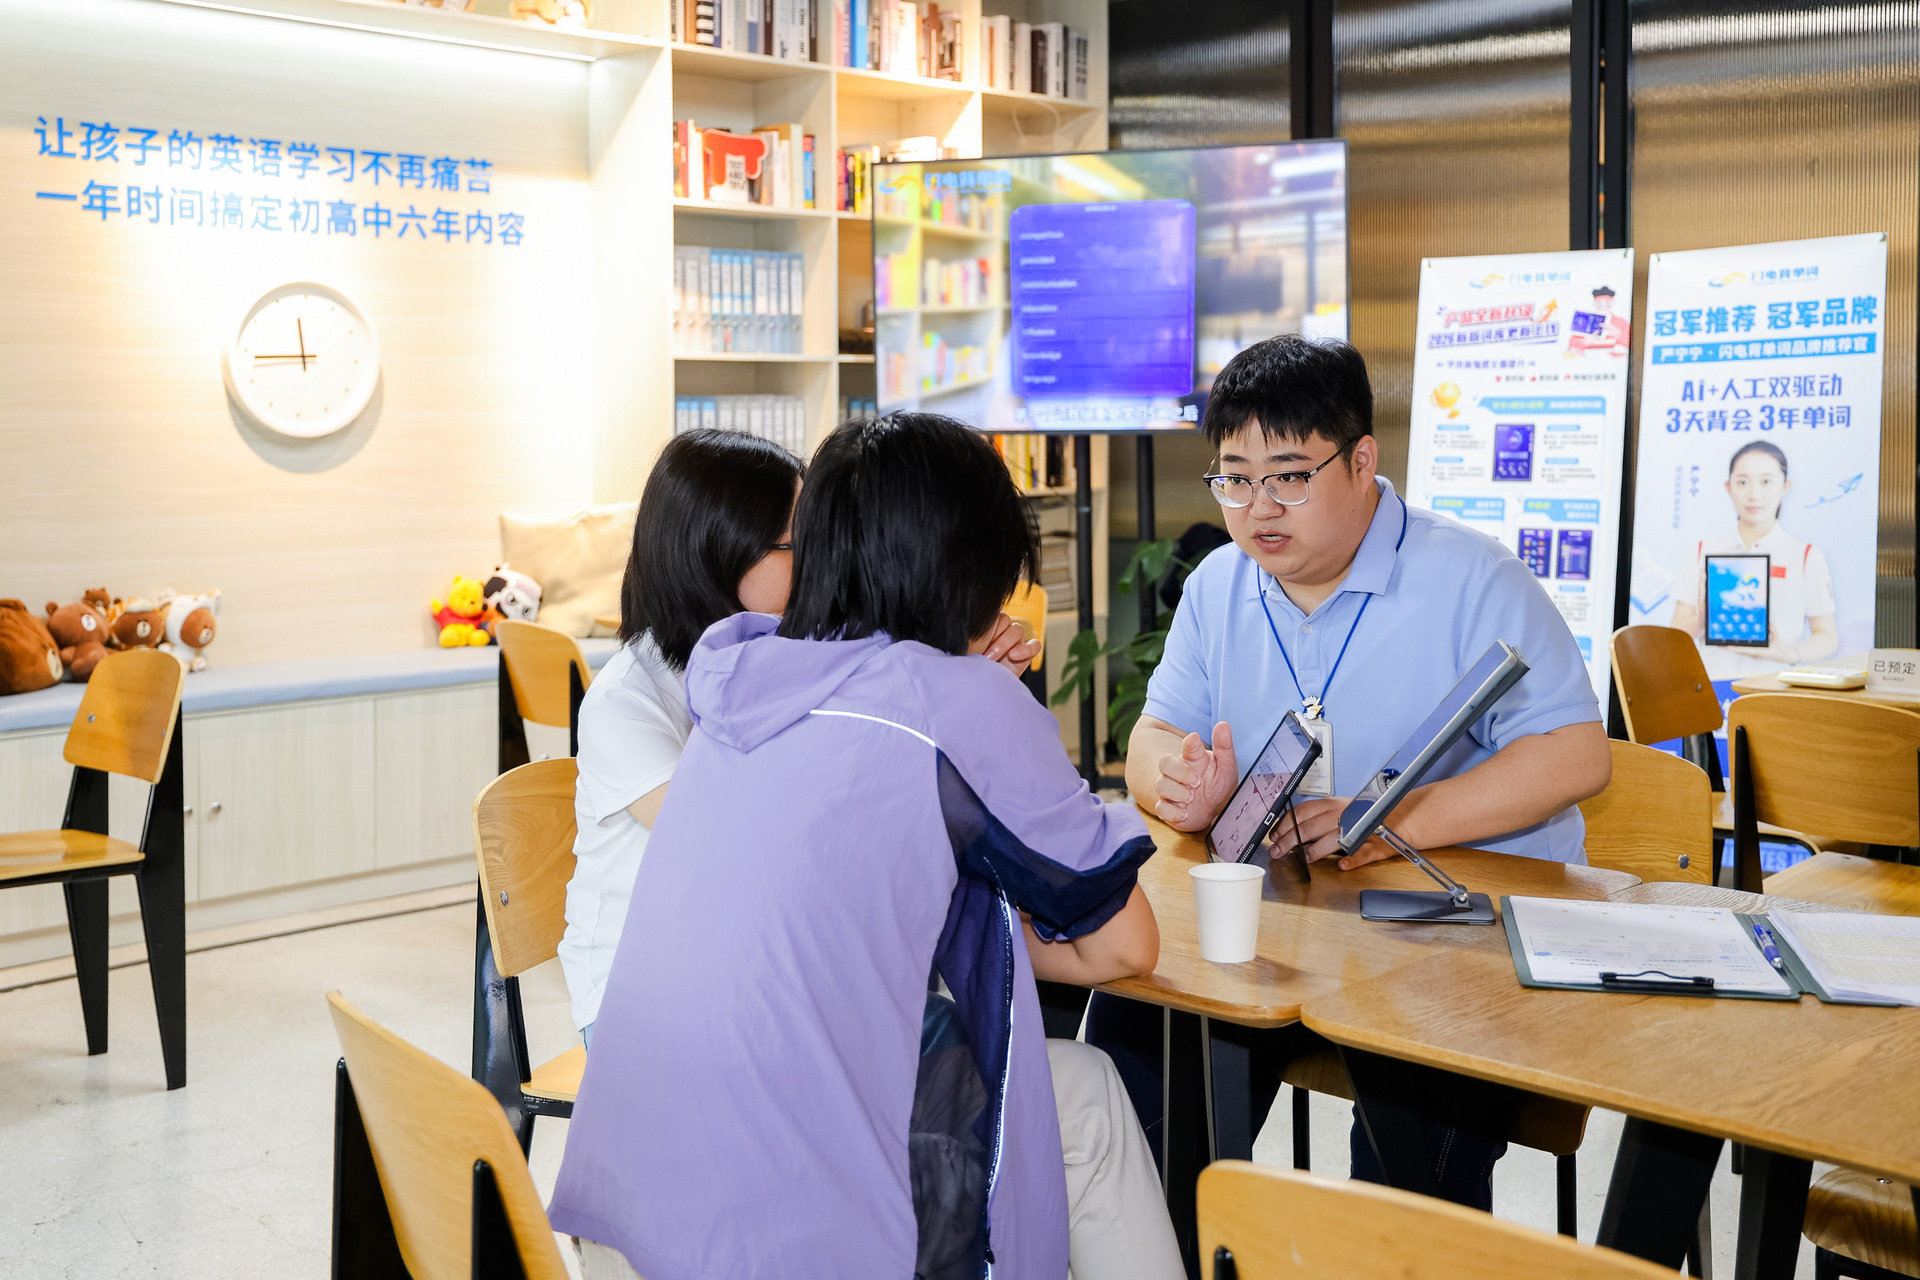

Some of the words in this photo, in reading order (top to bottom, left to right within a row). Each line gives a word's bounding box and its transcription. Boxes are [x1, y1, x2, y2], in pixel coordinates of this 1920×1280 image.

[34, 116, 494, 194] 让孩子的英语学习不再痛苦
[36, 179, 525, 246] 一年时间搞定初高中六年内容
[1654, 304, 1757, 336] 冠军推荐
[1767, 295, 1878, 330] 冠军品牌
[1681, 373, 1843, 402] Ai+人工双驱动
[1874, 660, 1916, 675] 已预定
